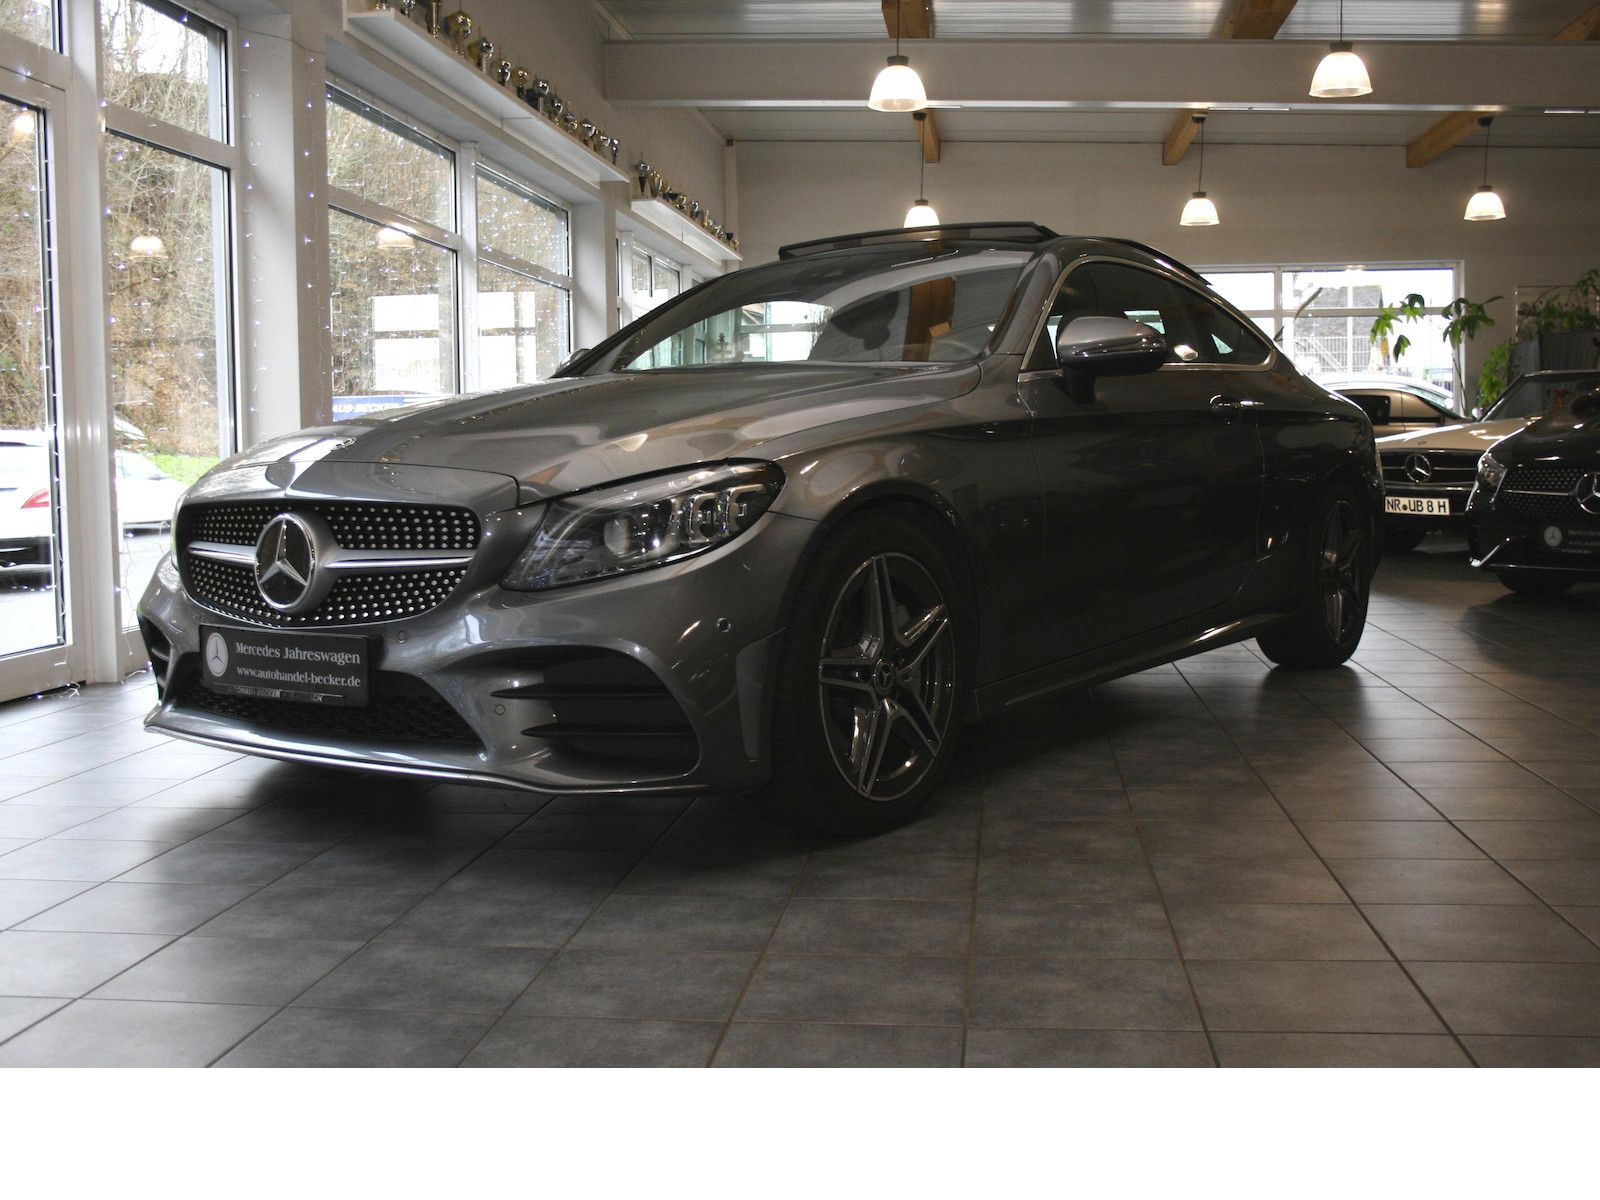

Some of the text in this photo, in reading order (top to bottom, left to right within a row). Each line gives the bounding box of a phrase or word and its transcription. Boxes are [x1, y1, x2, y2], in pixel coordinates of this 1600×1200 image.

[1386, 498, 1447, 513] NR UB 8 H
[235, 642, 361, 666] Mercedes Jahreswagen
[236, 665, 361, 688] www.autohandel-becker.de
